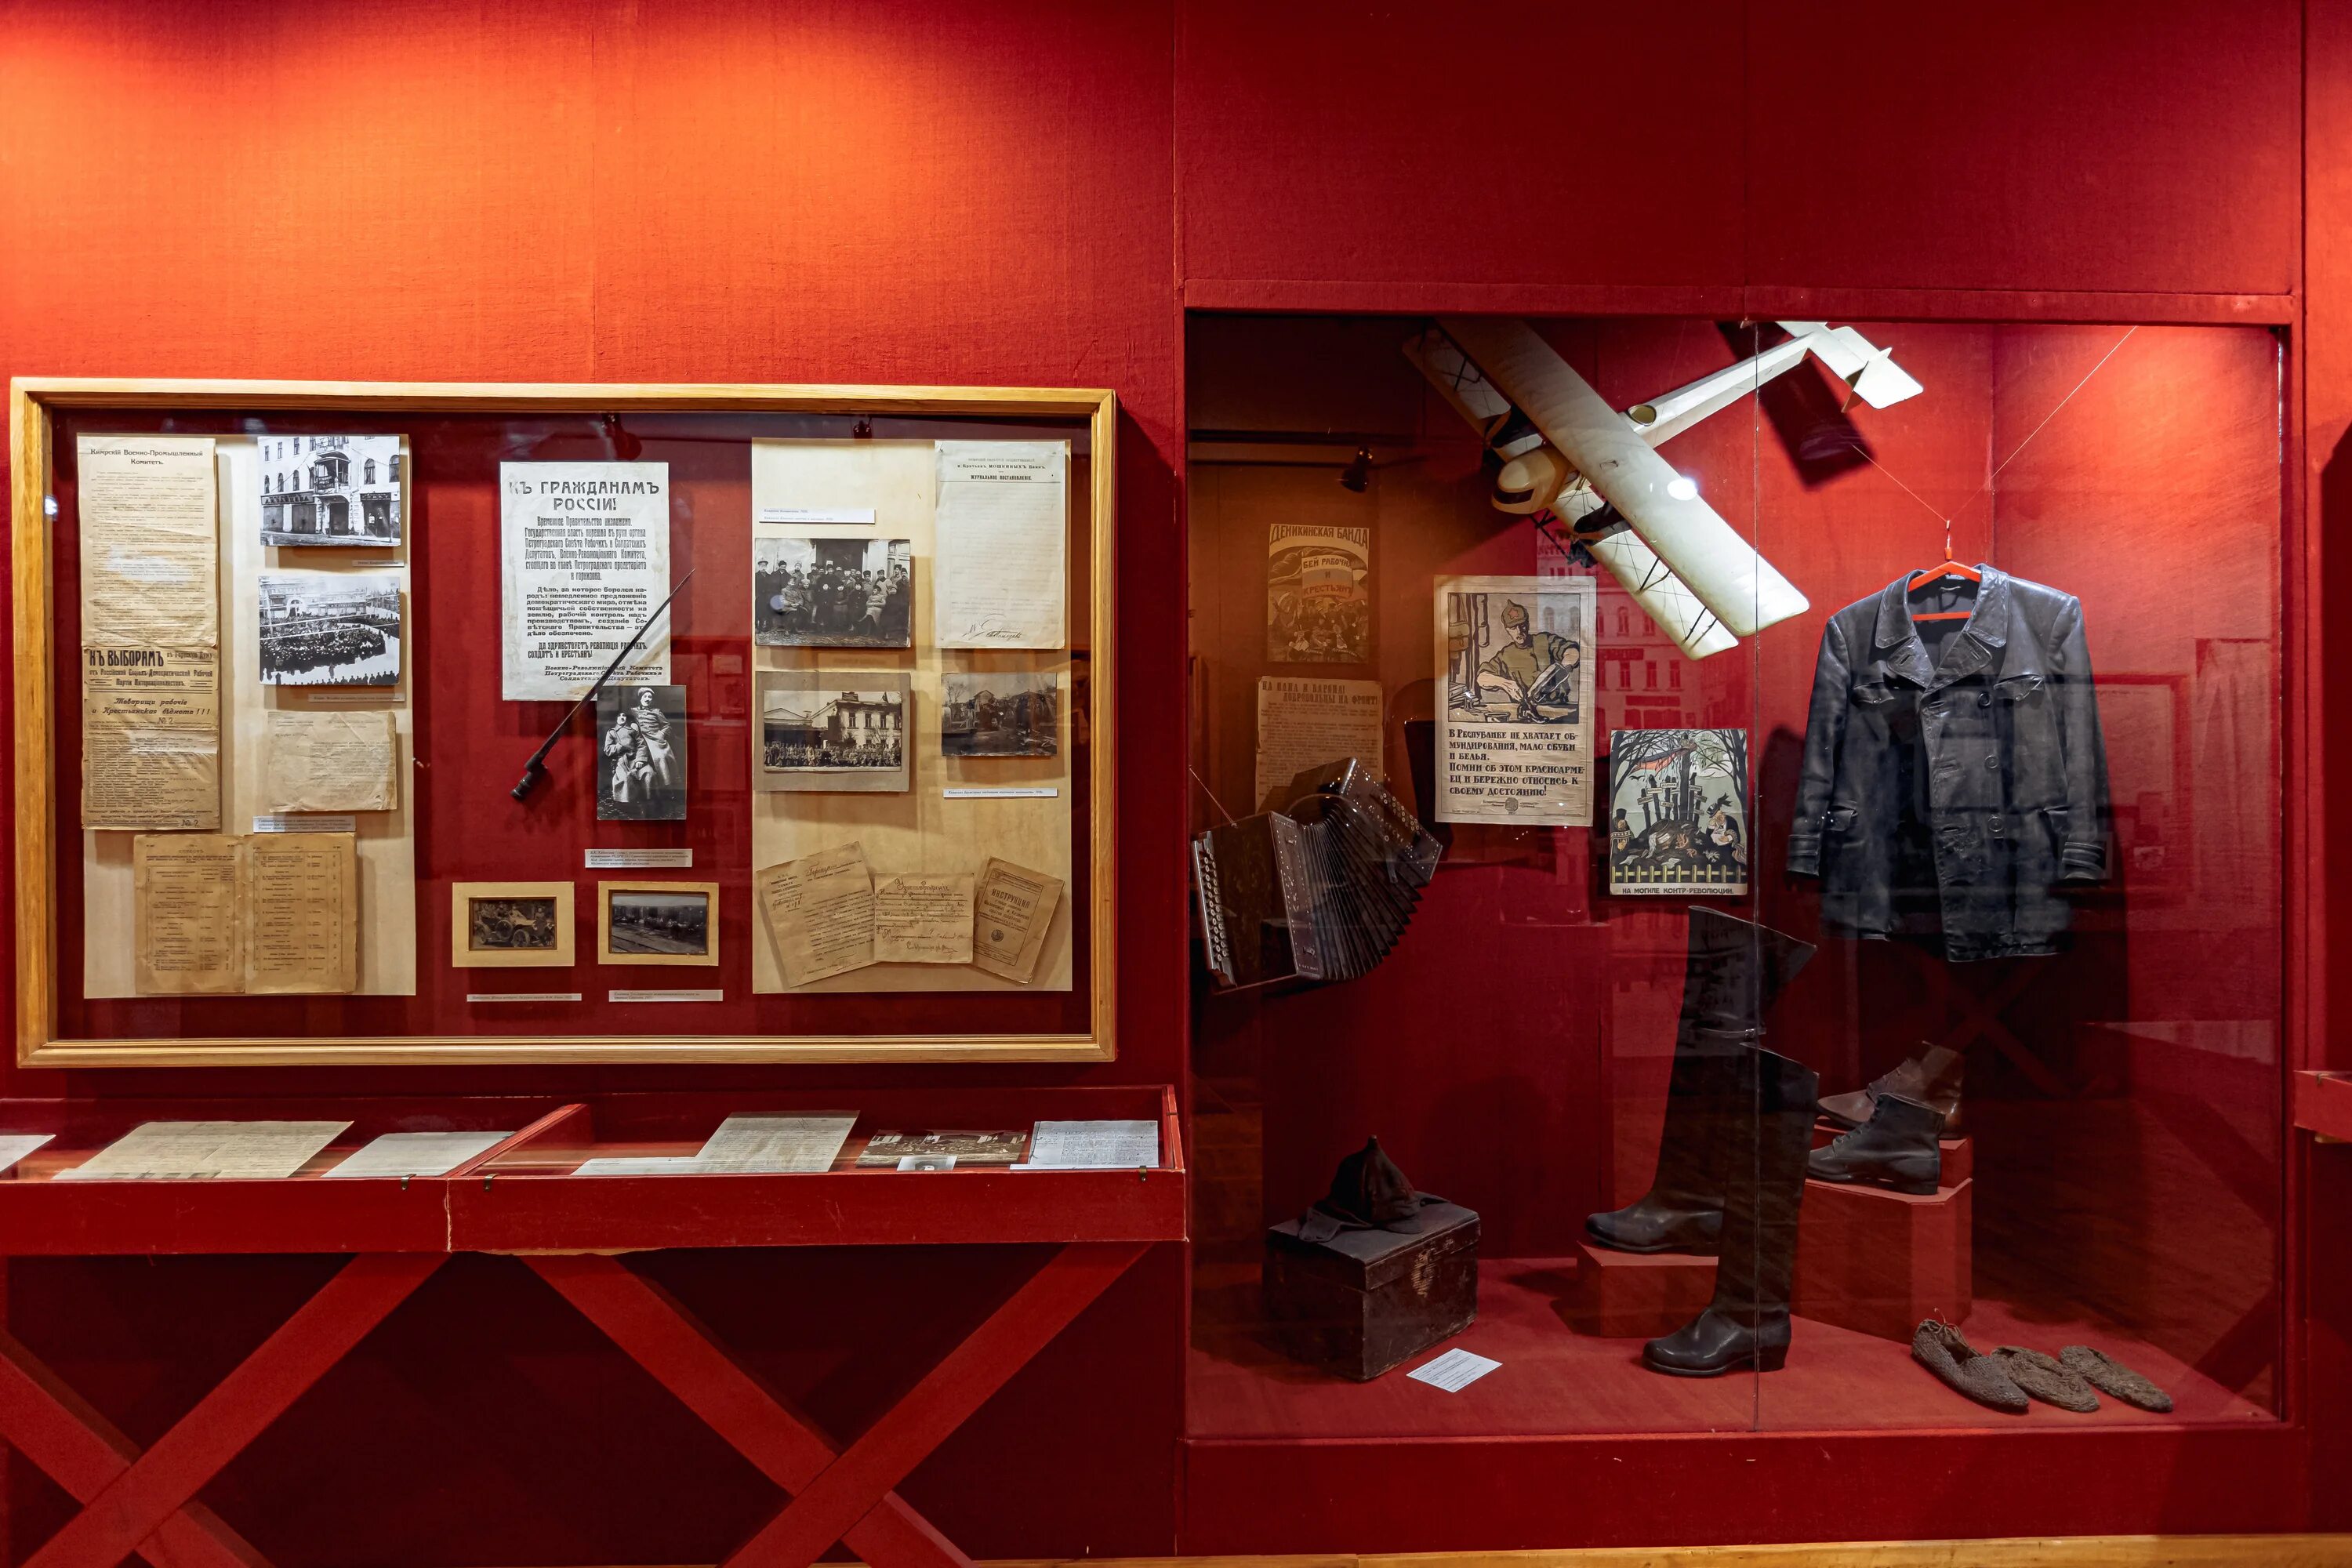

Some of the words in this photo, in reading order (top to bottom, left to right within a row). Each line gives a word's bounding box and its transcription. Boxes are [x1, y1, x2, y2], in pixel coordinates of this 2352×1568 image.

[90, 448, 121, 457] Кимрскій
[124, 448, 203, 457] Военно-Промышленный
[510, 481, 532, 495] КЪ
[541, 481, 659, 495] ГРАЖДАНАМЪ
[554, 497, 616, 510] РОССІИ!
[537, 516, 564, 527] Временное
[566, 516, 602, 527] Правительство
[605, 517, 632, 526] низложено.
[525, 528, 566, 538] Государственная
[568, 528, 583, 537] власть
[586, 529, 607, 538] перешла
[616, 529, 627, 538] руки
[1270, 525, 1334, 546] ДЕНИКИНСКАЯ
[1338, 528, 1368, 549] БАНДА
[525, 538, 563, 549] Петроградскаго
[565, 539, 583, 547] Совѣта
[585, 539, 608, 548] Рабочихъ
[615, 539, 646, 549] Солдатскихъ
[525, 549, 556, 560] Депутатовъ,
[621, 549, 646, 560] Комитета,
[525, 561, 549, 570] стоящаго
[558, 561, 572, 570] главѣ
[575, 560, 612, 570] Петроградскаго
[615, 561, 646, 570] пролетаріата
[1303, 557, 1319, 568] БЕЙ
[576, 572, 602, 581] гарнизона.
[90, 651, 104, 666] КЪ
[108, 650, 164, 666] ВЫБОРАМЪ
[1262, 681, 1272, 691] НА
[1277, 682, 1298, 691] ПАНА
[1303, 683, 1309, 691] И
[1312, 684, 1345, 694] БАРОНА!
[103, 707, 157, 716] Крестьянская
[1449, 729, 1455, 739] В
[1563, 732, 1579, 741] ОБ-
[1450, 742, 1518, 751] МУНДИРОВАНИЯ,
[1526, 765, 1585, 774] КРАСНОАРМЕ-
[1450, 775, 1461, 784] ЕЦ
[1523, 776, 1568, 785] ОТНОСИСЬ
[1571, 776, 1577, 785] К
[1487, 786, 1547, 796] ДОСТОЯНИЮ!
